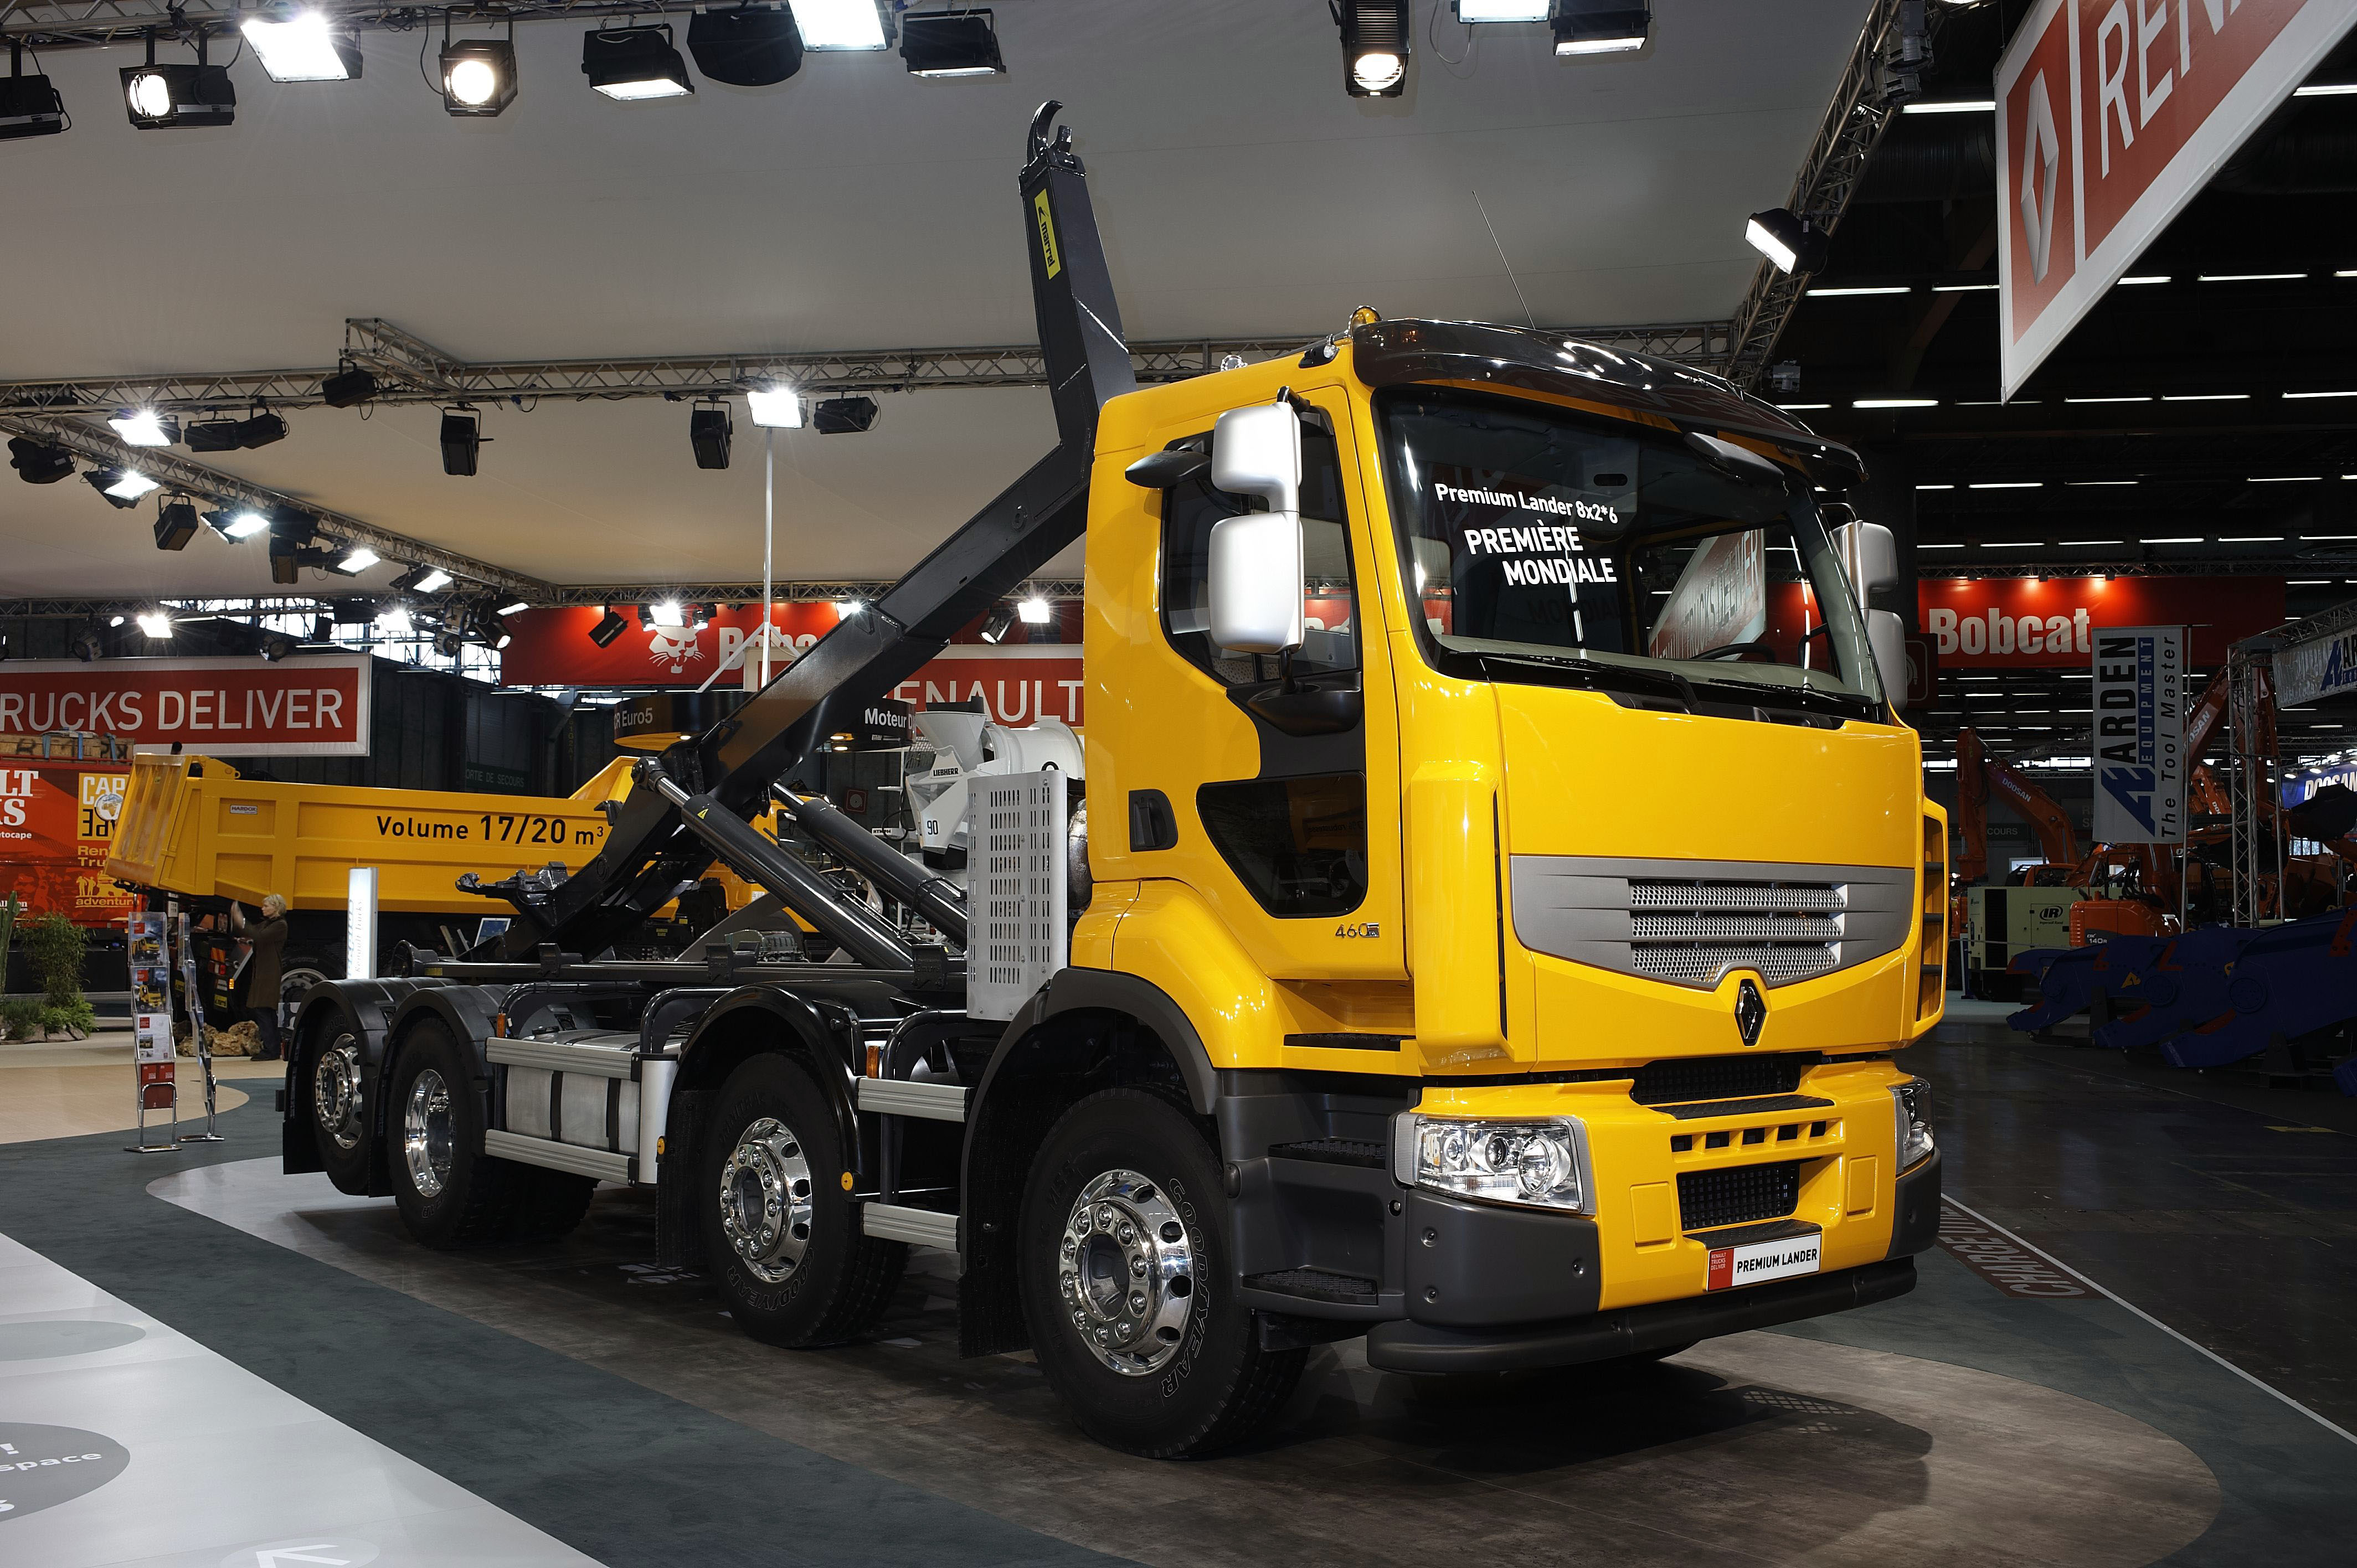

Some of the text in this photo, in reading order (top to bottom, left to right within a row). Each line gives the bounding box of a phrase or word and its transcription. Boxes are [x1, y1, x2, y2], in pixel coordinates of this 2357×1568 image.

[2098, 0, 2242, 179] RE
[1041, 221, 1055, 267] marrel
[1434, 483, 1517, 508] Premium
[1518, 491, 1573, 515] Lander
[1464, 519, 1583, 555] PREMIÈRE
[1502, 558, 1617, 586] MONDIALE
[1929, 608, 2091, 654] Bobcat
[0, 688, 343, 731] RUCKS DELIVER
[883, 680, 1084, 722] ENAULT
[2099, 637, 2137, 764] ARDEN
[2141, 641, 2153, 761] EQUIPMENT
[622, 707, 653, 727] Euro5
[865, 708, 907, 729] Moteur
[2161, 637, 2176, 837] The Tool Master
[486, 772, 495, 783] DE
[497, 773, 524, 787] SECOURS
[933, 768, 959, 776] LIEBHERR
[2002, 777, 2031, 802] DOOSAN
[377, 816, 469, 839] Volume
[481, 815, 565, 844] 17/20
[927, 820, 939, 835] 90
[76, 897, 140, 906] adventure
[2044, 909, 2058, 917] IR
[1335, 923, 1368, 938] 460
[1737, 1248, 1818, 1273] PREMIUM LANDER
[1939, 1237, 2086, 1296] CHARGE
[727, 1246, 815, 1311] GOODYEAR
[1161, 1177, 1210, 1398] GOODYEAR
